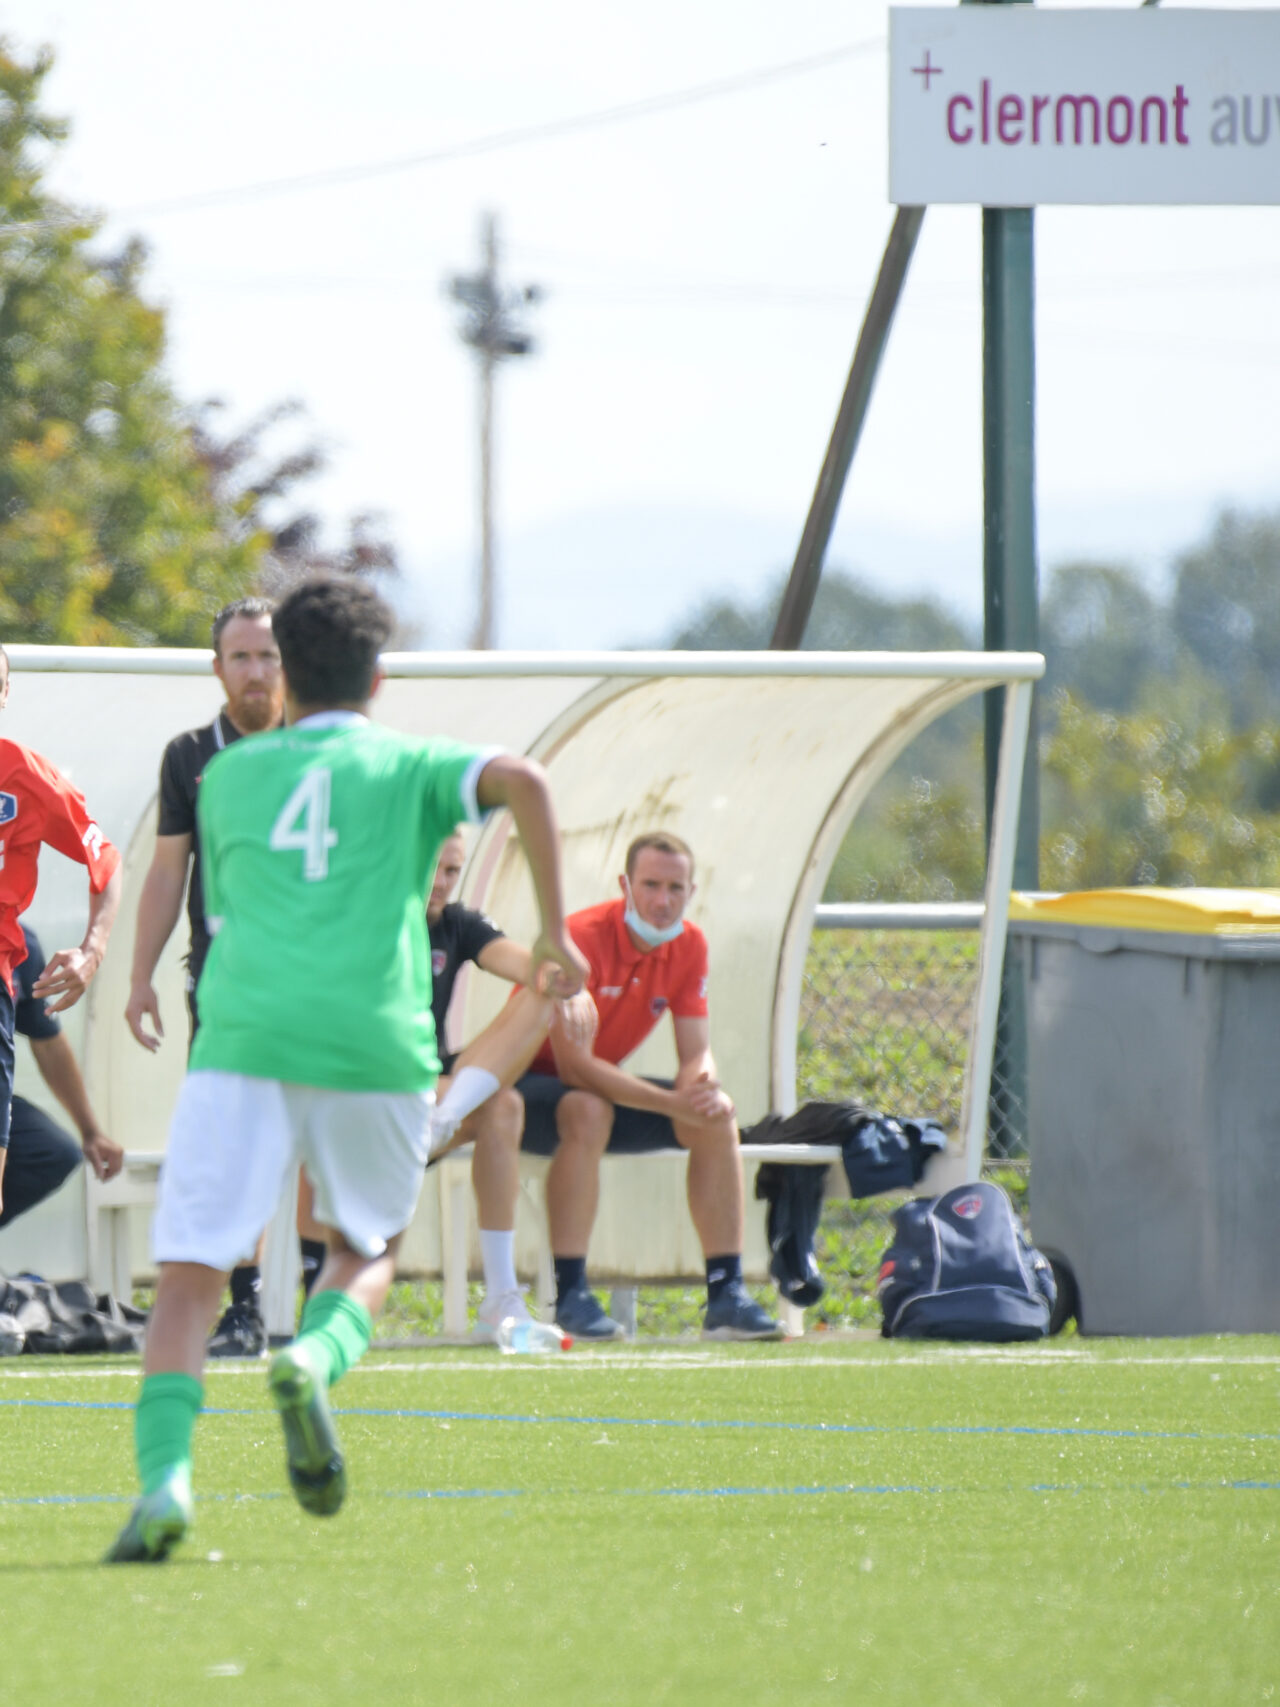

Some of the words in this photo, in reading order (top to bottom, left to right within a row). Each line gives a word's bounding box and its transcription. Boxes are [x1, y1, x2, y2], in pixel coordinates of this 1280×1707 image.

[947, 77, 1190, 145] clermont
[1210, 94, 1280, 146] au
[270, 768, 338, 882] 4
